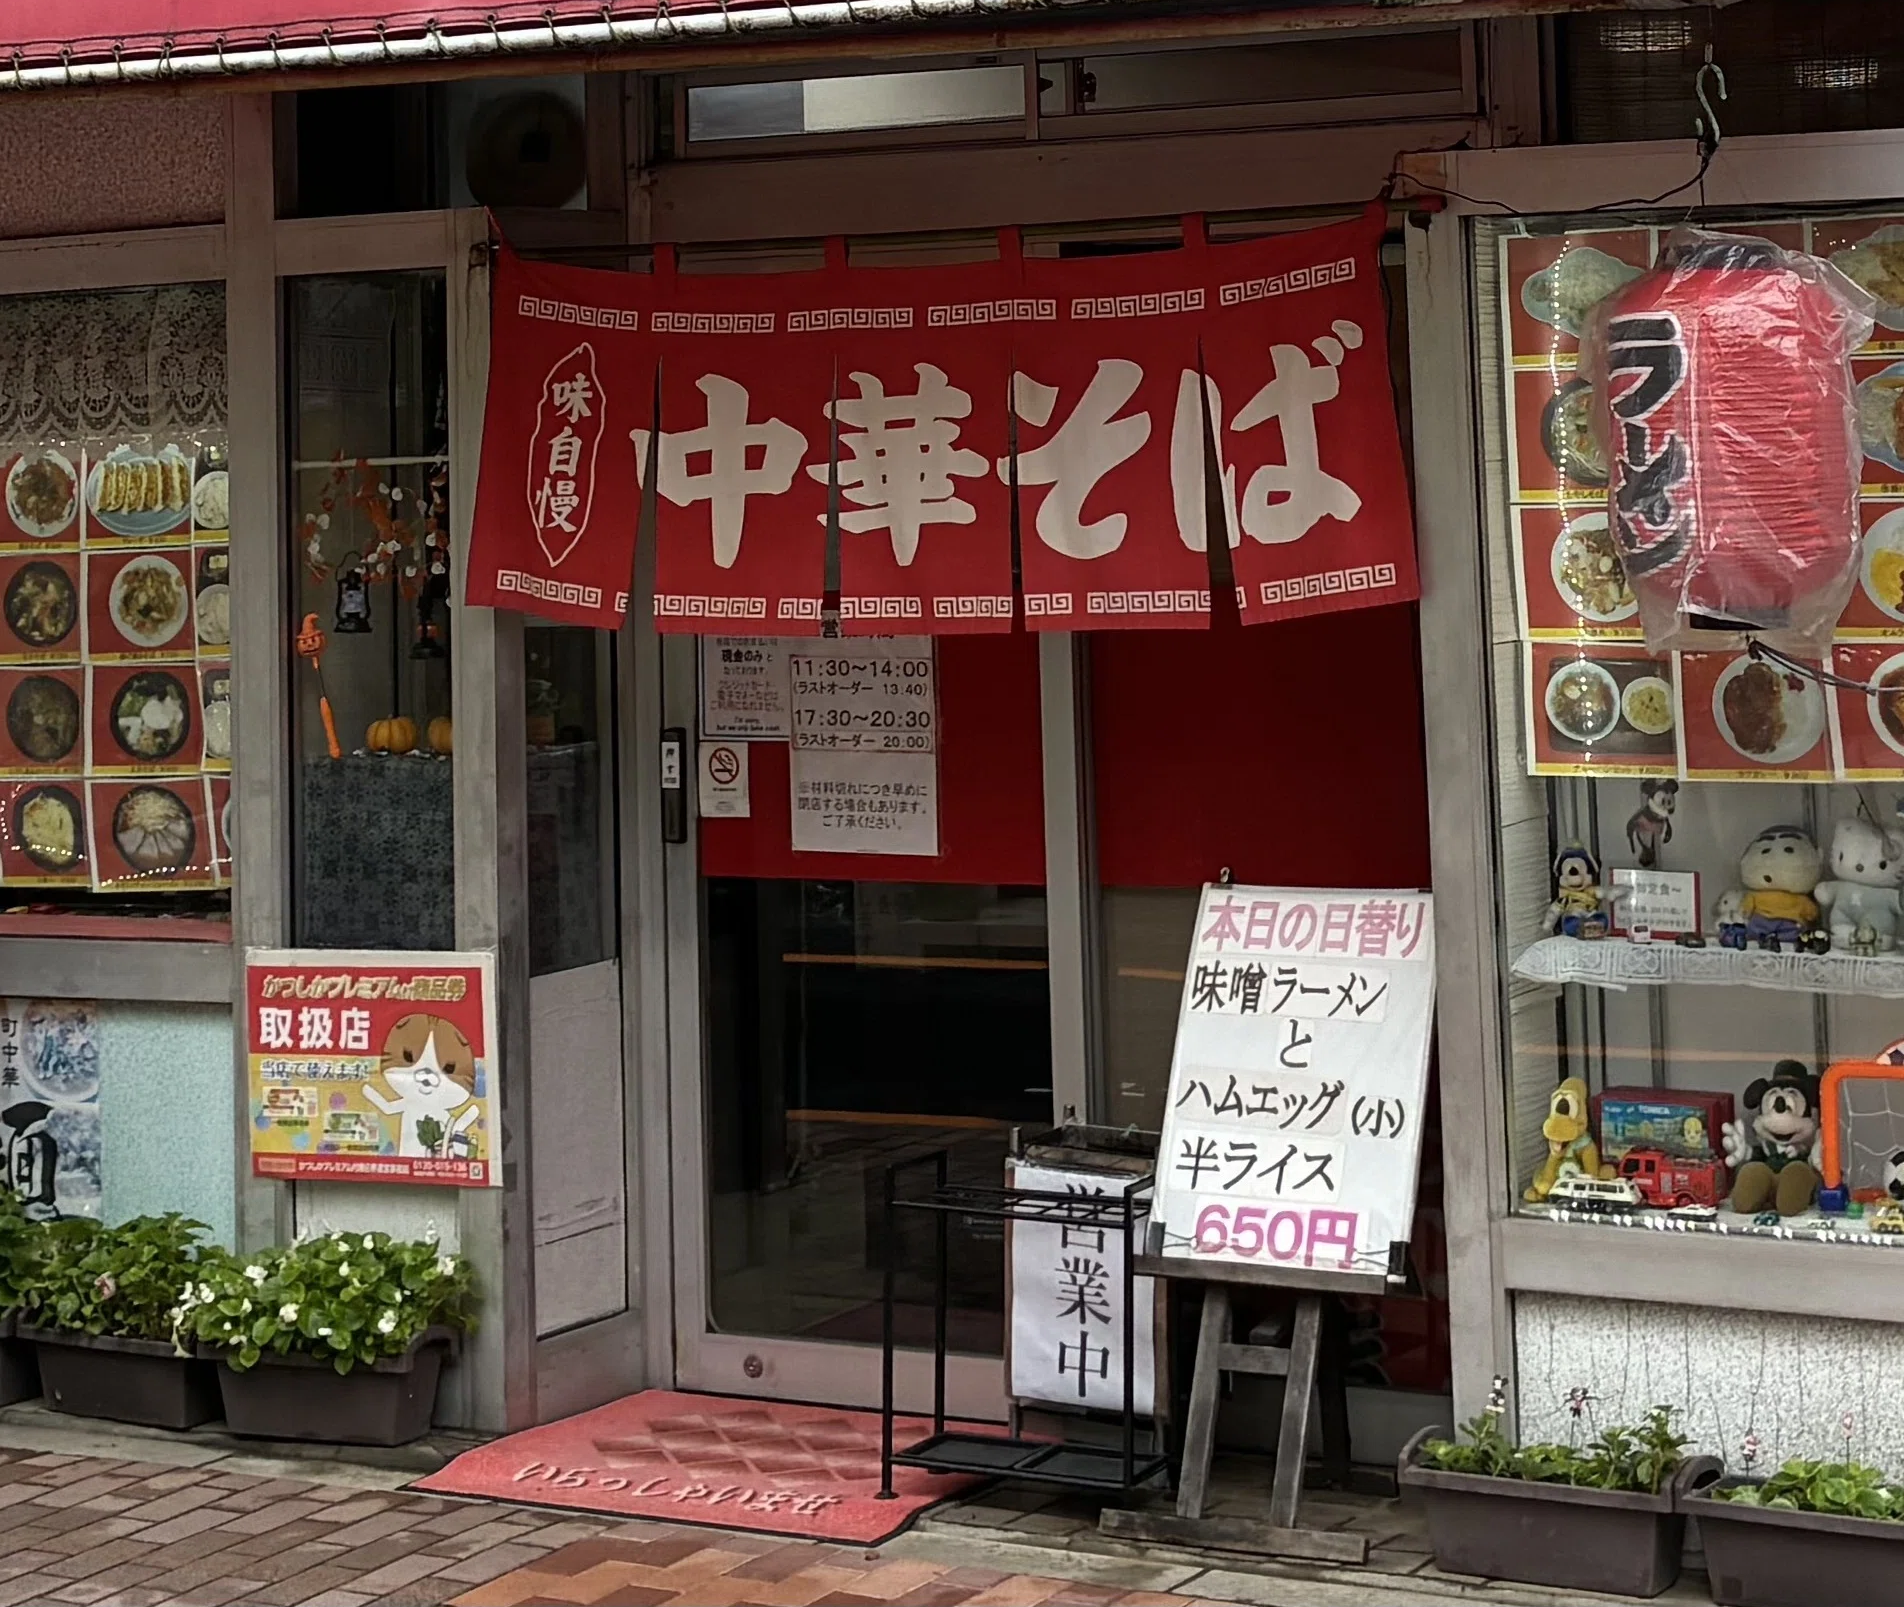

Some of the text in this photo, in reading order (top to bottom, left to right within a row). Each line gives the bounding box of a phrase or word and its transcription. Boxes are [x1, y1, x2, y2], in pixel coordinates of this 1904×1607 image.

[532, 372, 594, 534] 味自慢
[632, 318, 1364, 570] 中華そば
[1201, 894, 1426, 959] 本日の日替り
[1191, 960, 1388, 1018] 味噌ラーメン
[1, 1017, 21, 1088] 町中華
[258, 1006, 371, 1051] 取扱店
[1279, 1019, 1313, 1069] と
[1175, 1136, 1336, 1195] 半ライス
[1196, 1204, 1358, 1269] 650円
[1054, 1182, 1113, 1398] 営業中
